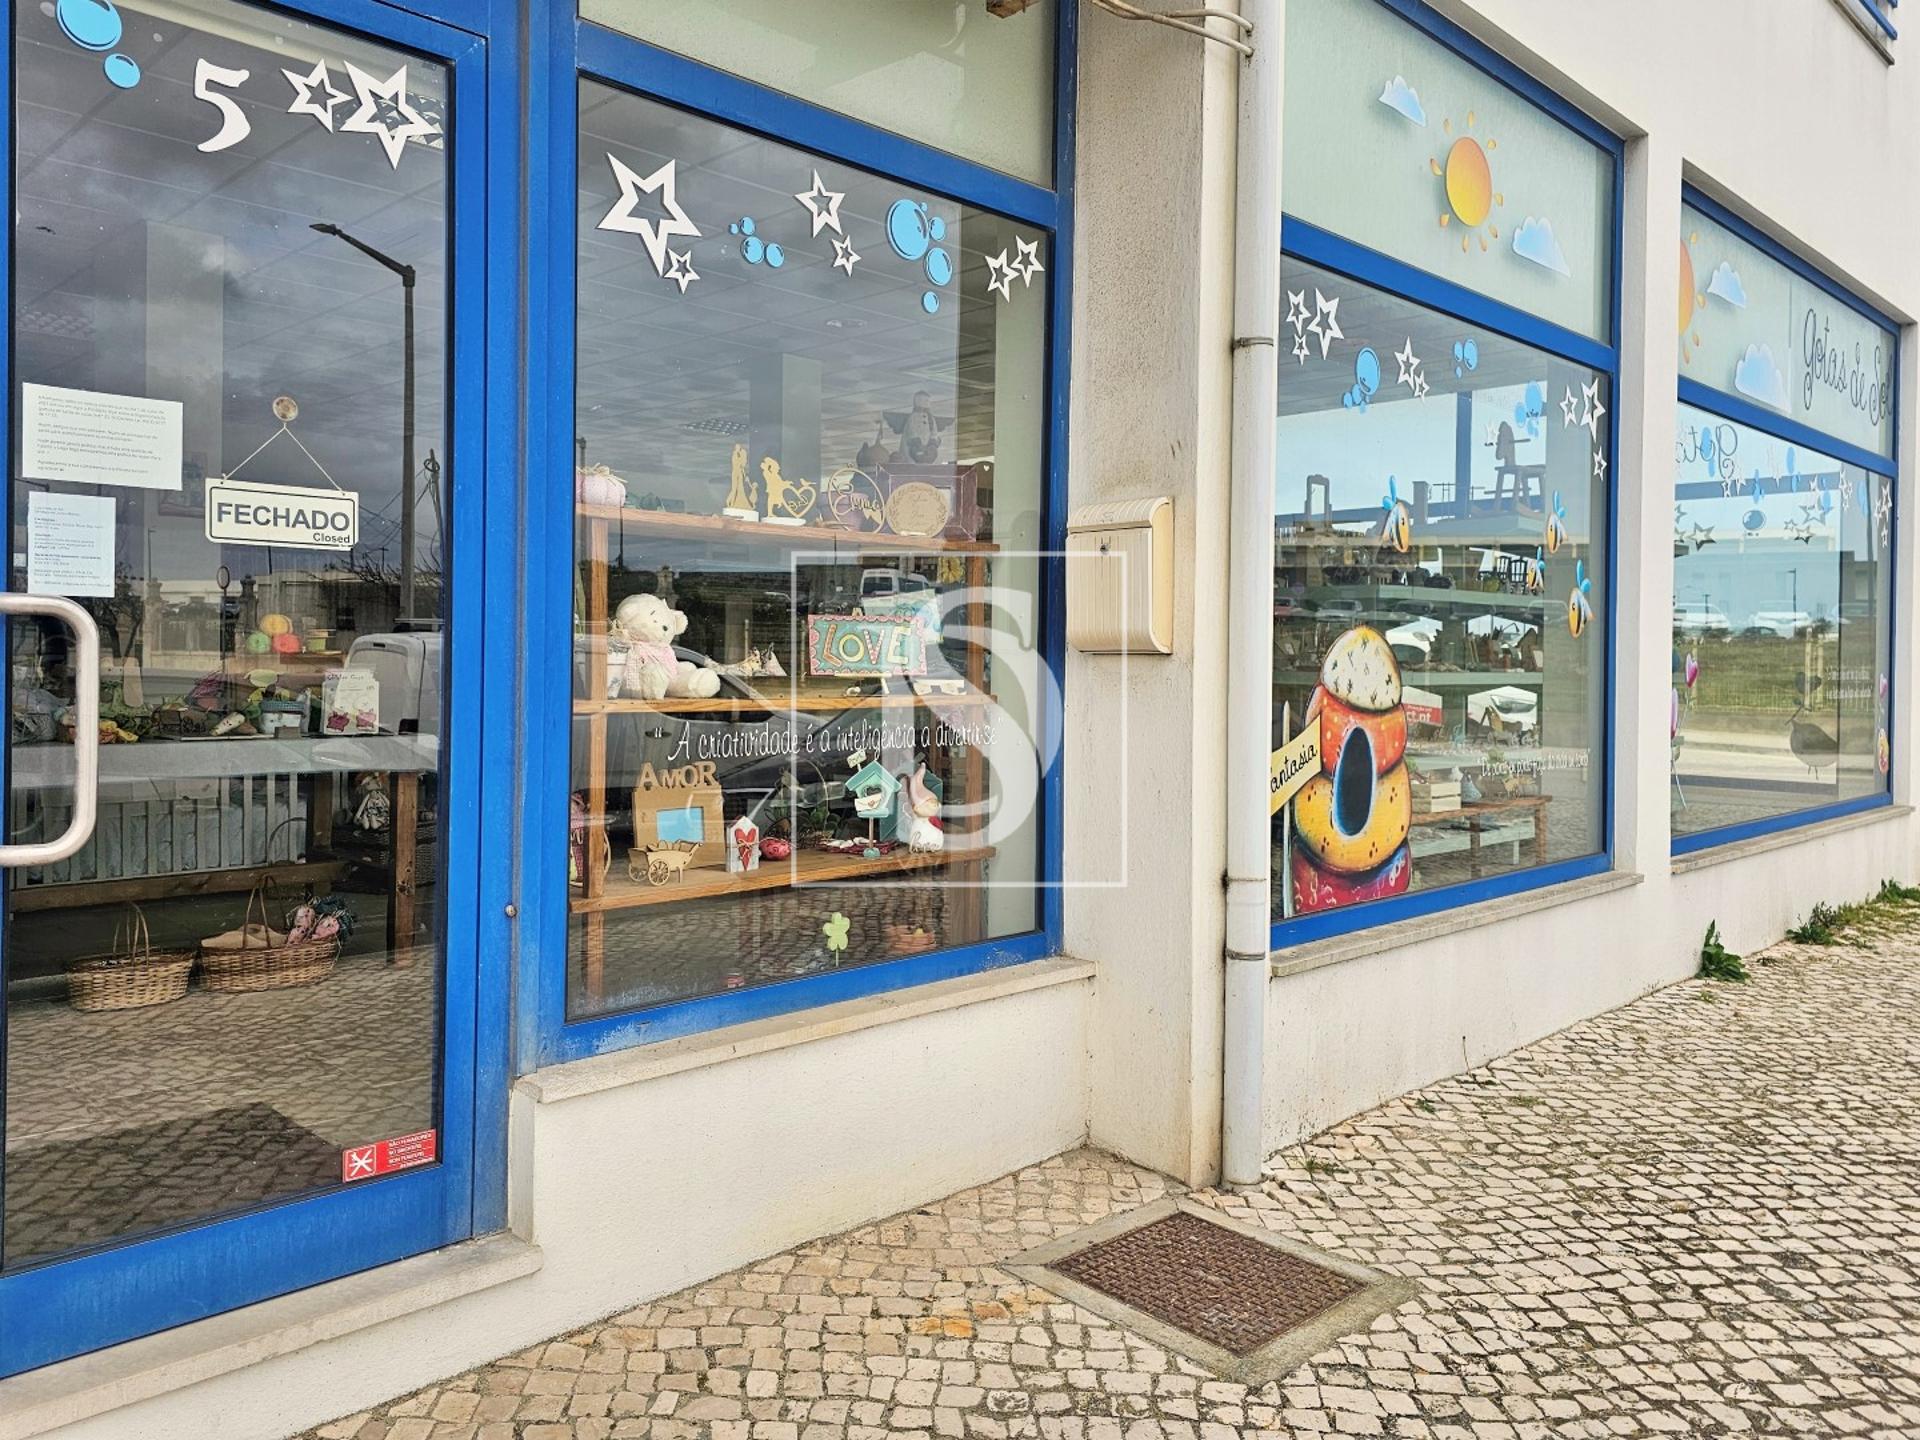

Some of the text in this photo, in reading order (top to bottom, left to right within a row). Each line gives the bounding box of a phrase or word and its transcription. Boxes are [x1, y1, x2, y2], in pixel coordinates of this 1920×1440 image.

[194, 58, 251, 152] 5
[1851, 341, 1867, 411] de
[217, 502, 350, 532] FECHADO
[312, 532, 351, 544] Closed
[823, 624, 912, 667] LOVE
[667, 720, 690, 761] A
[699, 722, 800, 760] criatividade
[806, 723, 815, 753] é
[820, 729, 831, 752] a
[836, 718, 916, 760] inteligência
[920, 726, 932, 746] a
[639, 760, 720, 790] AMOR
[1271, 744, 1317, 793] antasia
